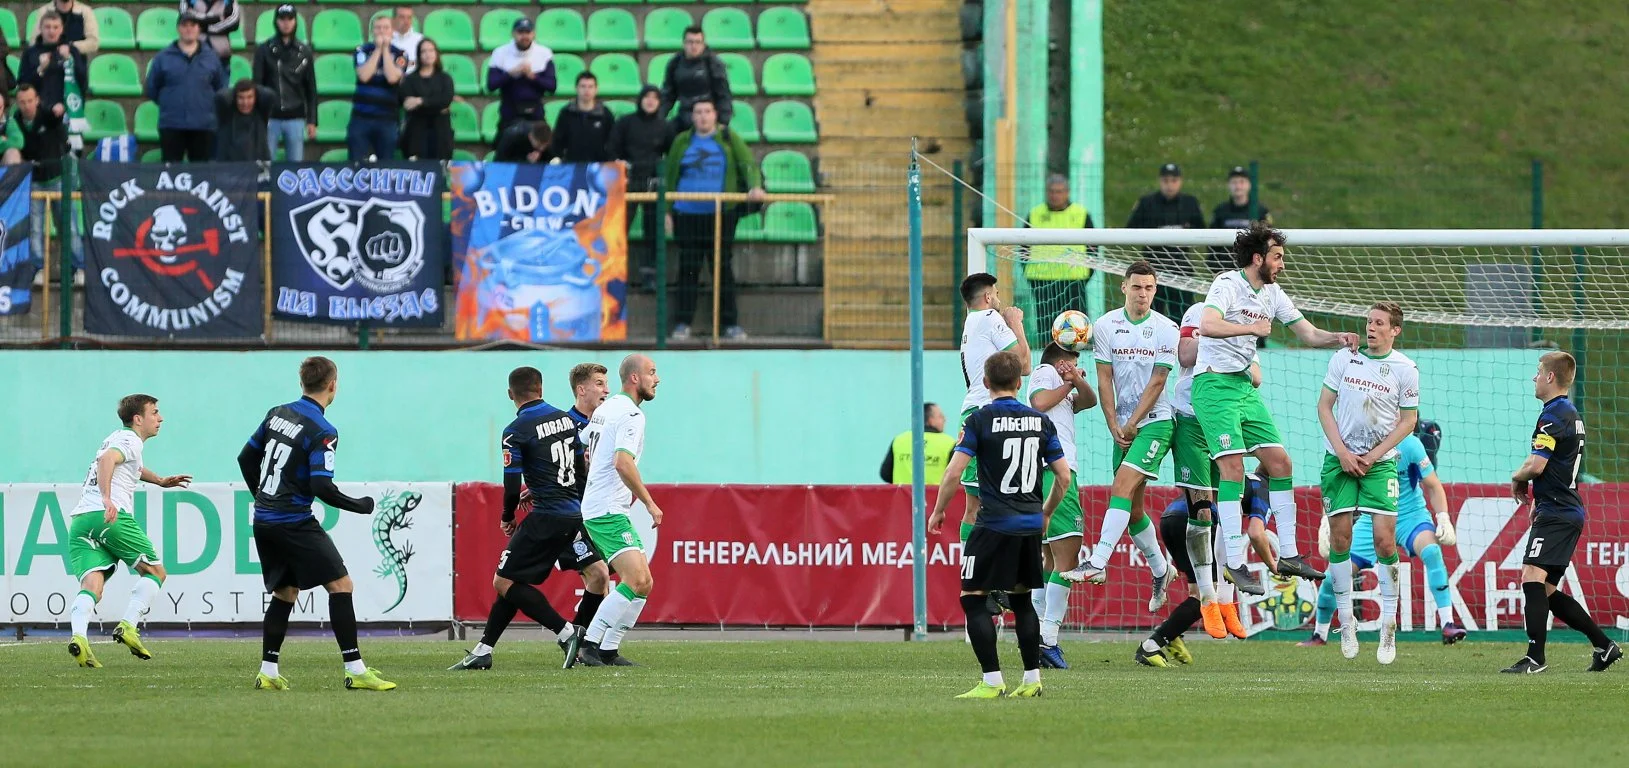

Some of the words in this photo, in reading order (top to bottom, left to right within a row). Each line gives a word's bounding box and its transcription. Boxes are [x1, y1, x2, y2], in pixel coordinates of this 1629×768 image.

[93, 178, 145, 242] ROCK
[156, 171, 249, 245] AGAINST
[473, 185, 600, 218] BIDON
[101, 267, 245, 330] COMMUNISM
[277, 286, 317, 317] НА
[1343, 376, 1391, 394] MARATHON
[991, 416, 1042, 433] БАБЕНКО
[550, 436, 576, 487] 25
[1147, 439, 1161, 460] 9
[258, 438, 293, 496] 13
[1000, 436, 1040, 494] 20
[673, 539, 852, 567] ГЕНЕРАЛЬНИЙ
[1528, 538, 1545, 558] 5
[960, 556, 976, 579] 20
[139, 591, 314, 615] YSTEM
